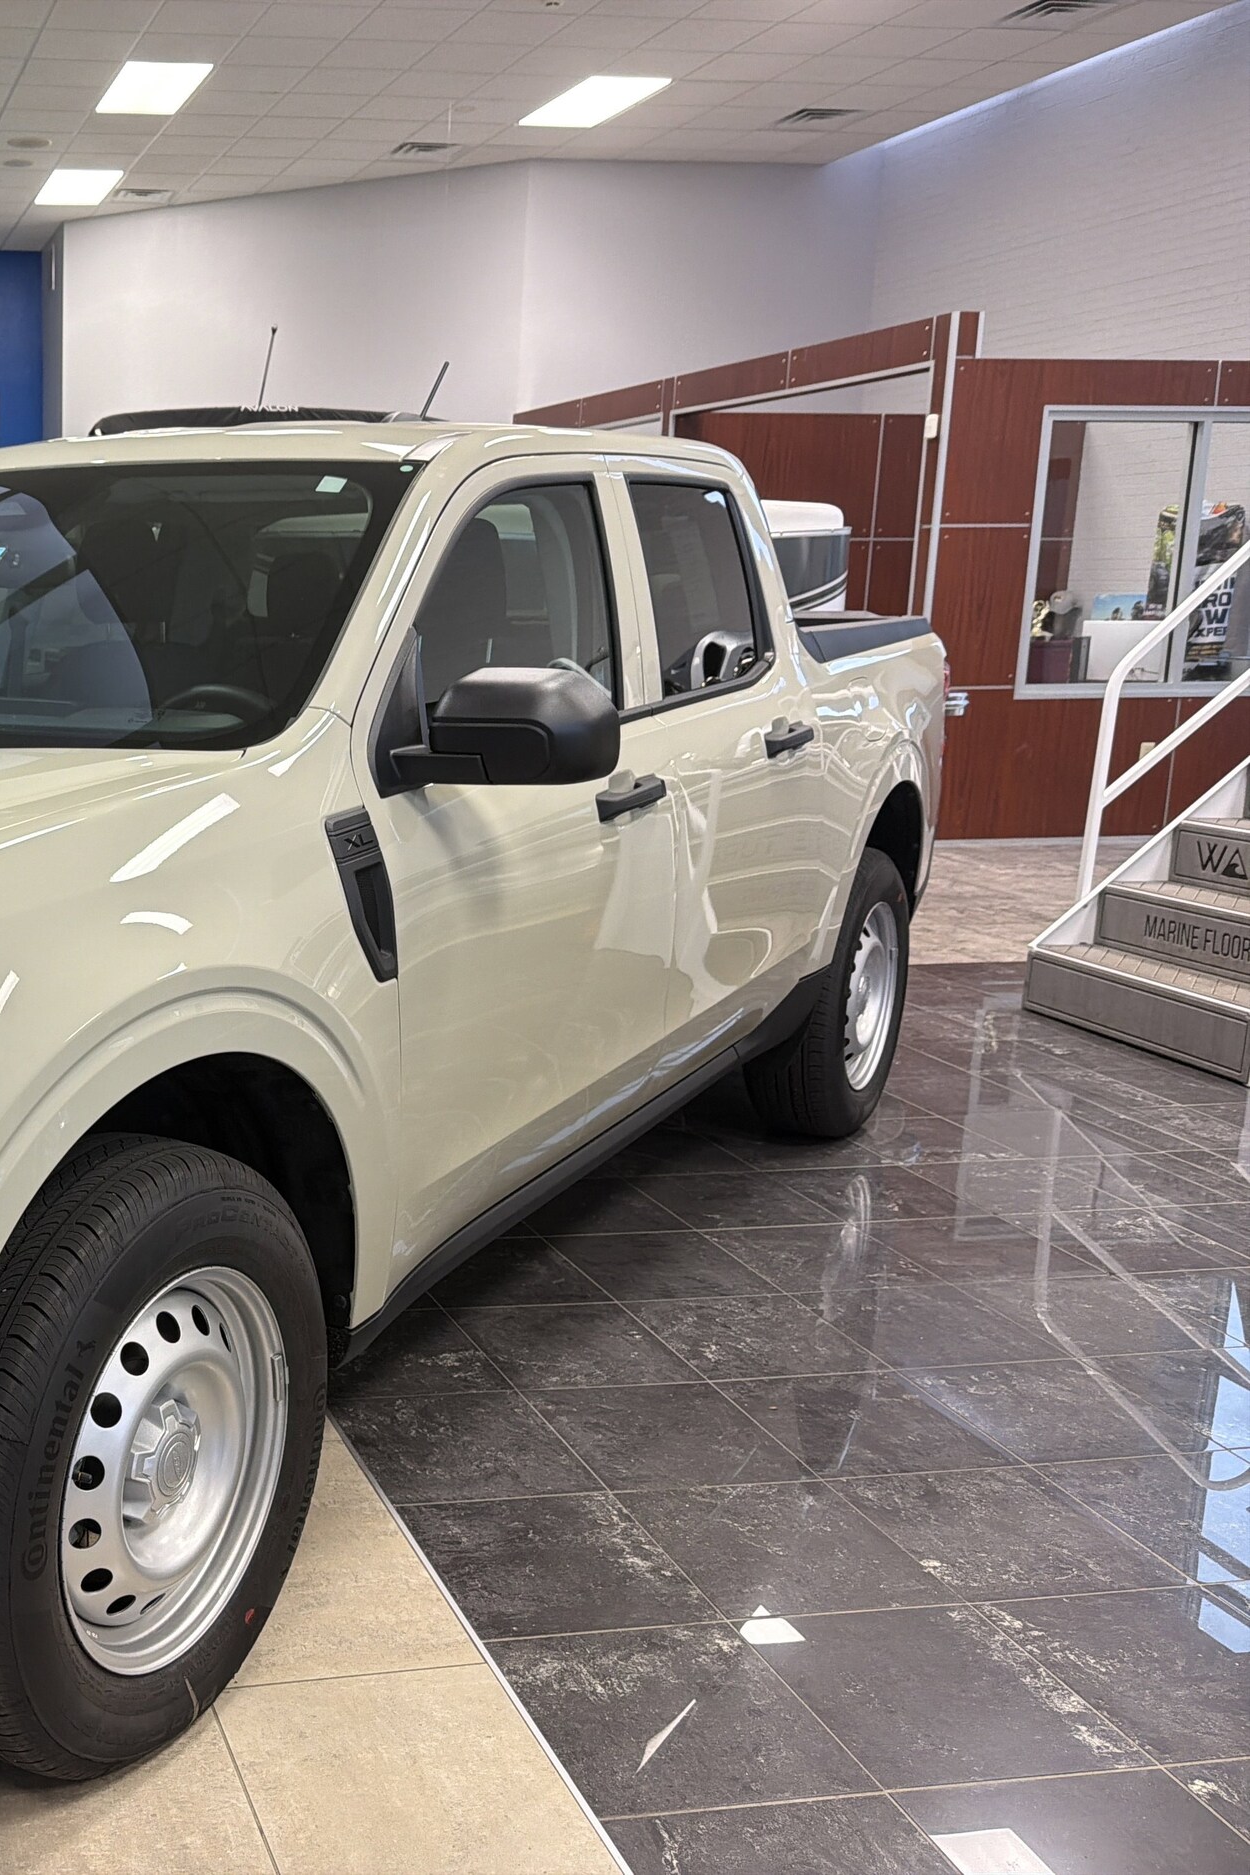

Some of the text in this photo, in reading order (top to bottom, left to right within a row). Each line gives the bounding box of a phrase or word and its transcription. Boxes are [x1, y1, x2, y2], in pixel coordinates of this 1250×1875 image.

[240, 404, 300, 413] AVALON
[1202, 591, 1232, 608] RO
[343, 834, 374, 852] XL
[1144, 914, 1201, 951] MARINE
[22, 1361, 86, 1582] Continental
